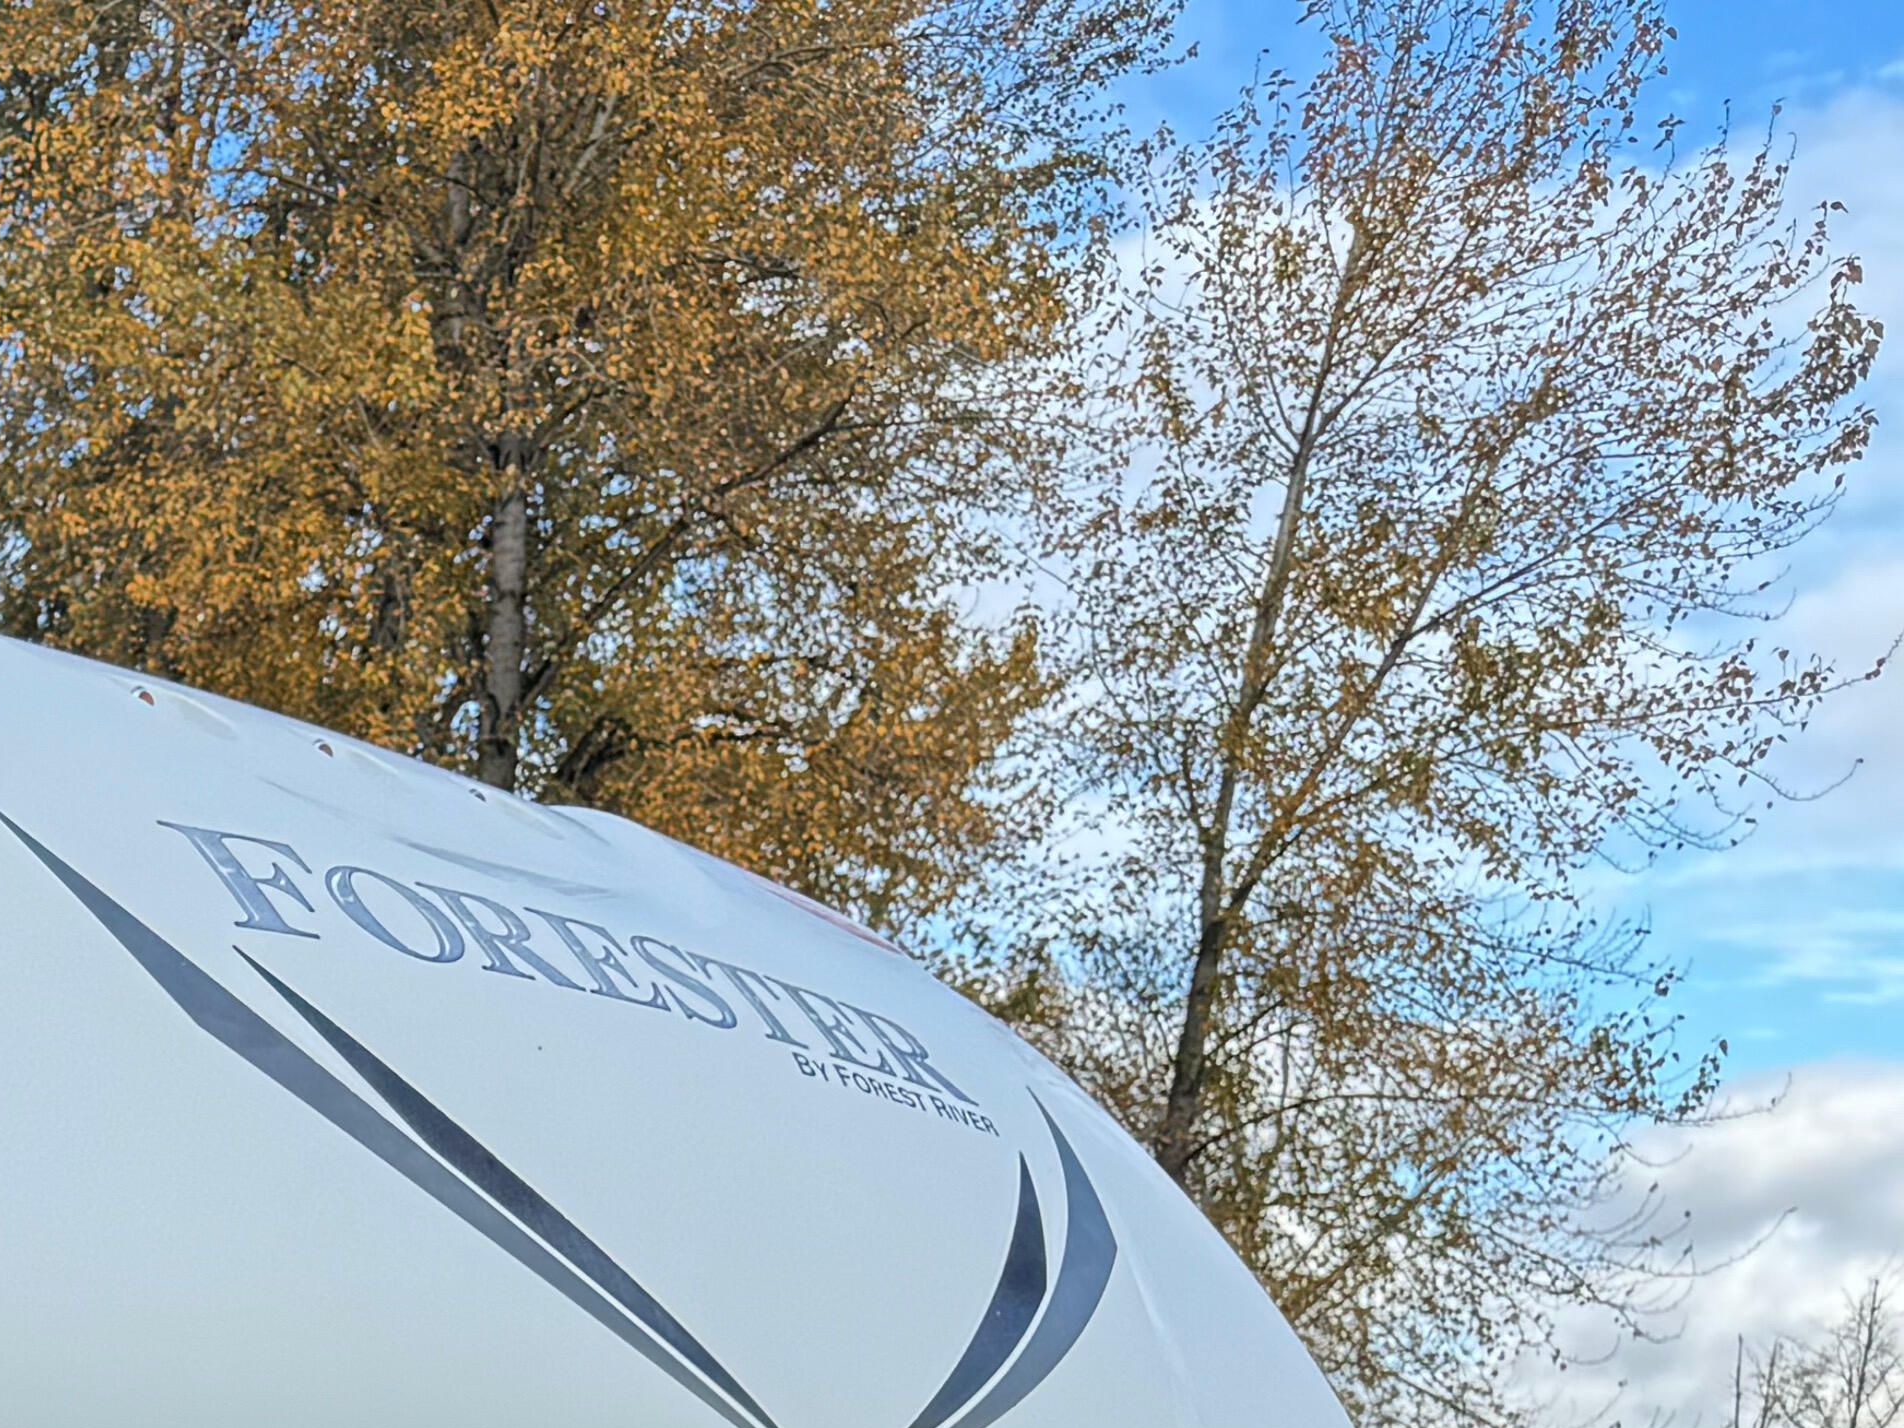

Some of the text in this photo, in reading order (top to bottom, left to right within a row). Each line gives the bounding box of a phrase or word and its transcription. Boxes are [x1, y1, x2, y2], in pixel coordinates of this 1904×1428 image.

[156, 819, 980, 1107] FORESTER
[791, 1051, 1001, 1138] BY FOREST RIVER
